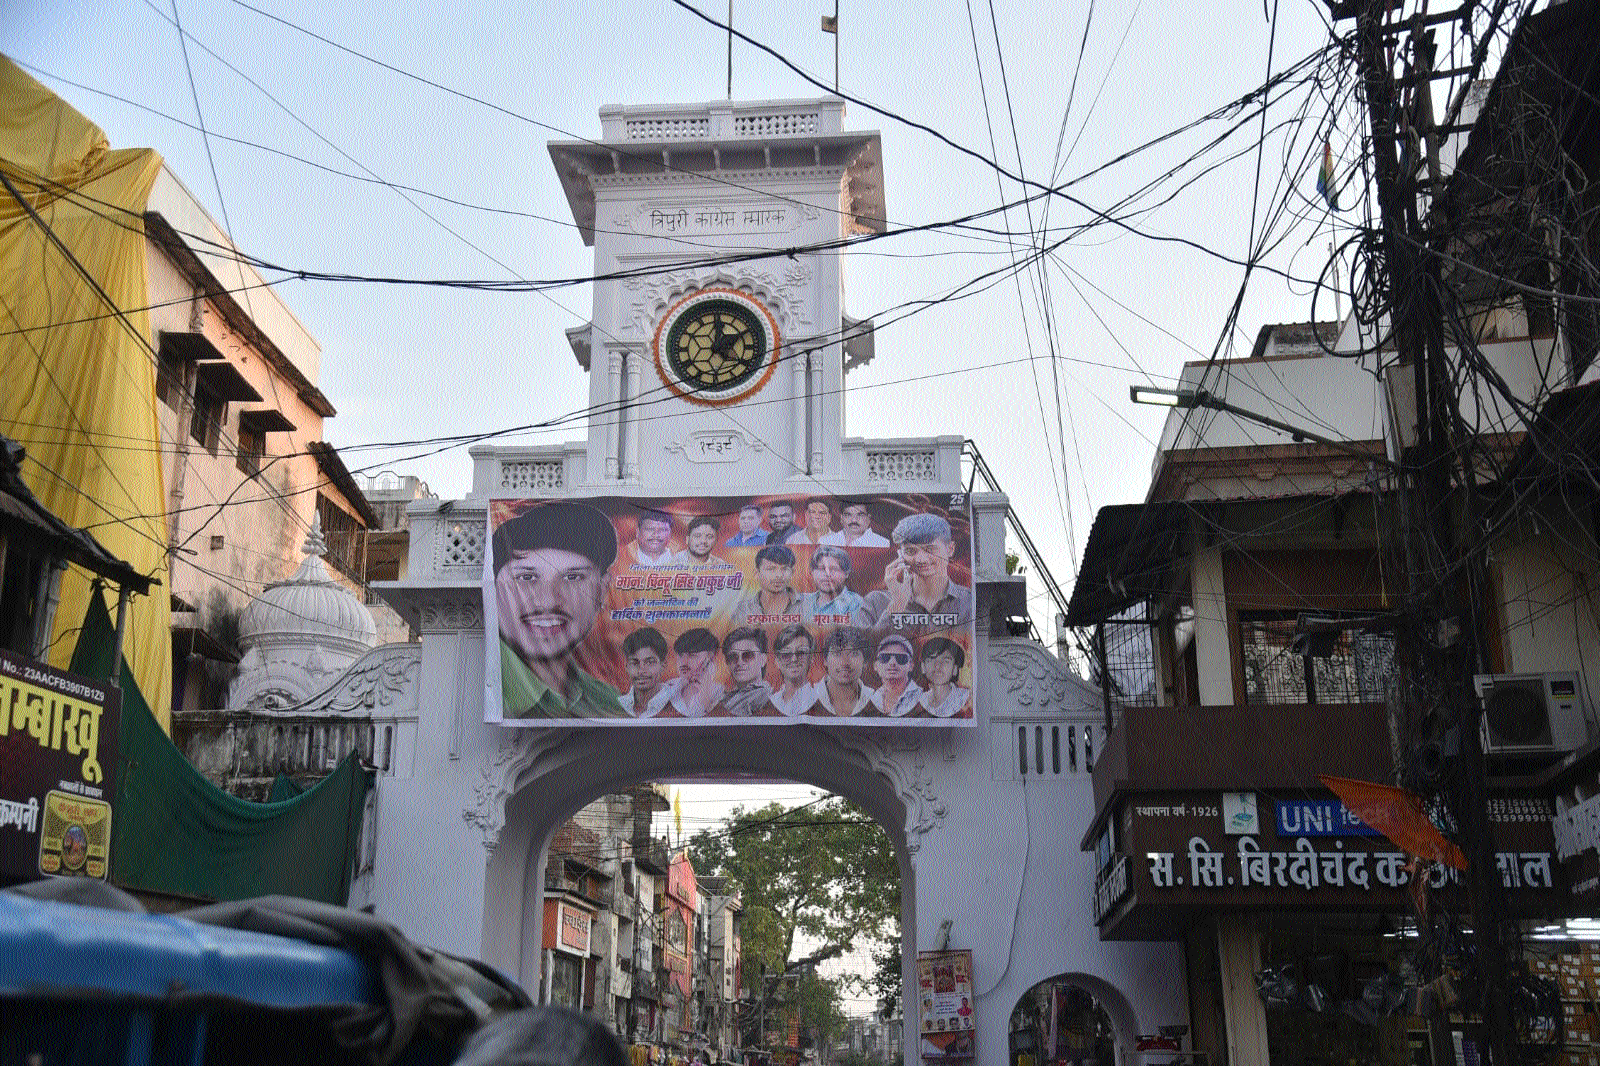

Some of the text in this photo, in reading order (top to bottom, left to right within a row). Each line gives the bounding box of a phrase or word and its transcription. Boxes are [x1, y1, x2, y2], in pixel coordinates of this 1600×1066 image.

[650, 209, 688, 231] त्रिपुरी
[695, 207, 736, 227] कांग्रेस
[949, 494, 965, 505] 25
[726, 572, 743, 589] जी
[781, 614, 801, 623] दादा
[832, 612, 850, 623] भाई
[892, 613, 959, 630] सुजात दादा
[1136, 805, 1169, 817] स्थापना
[1281, 805, 1333, 833] UNI
[1146, 852, 1183, 887] स.
[1187, 836, 1234, 887] सि.
[1237, 836, 1370, 890] बिरदीचंद
